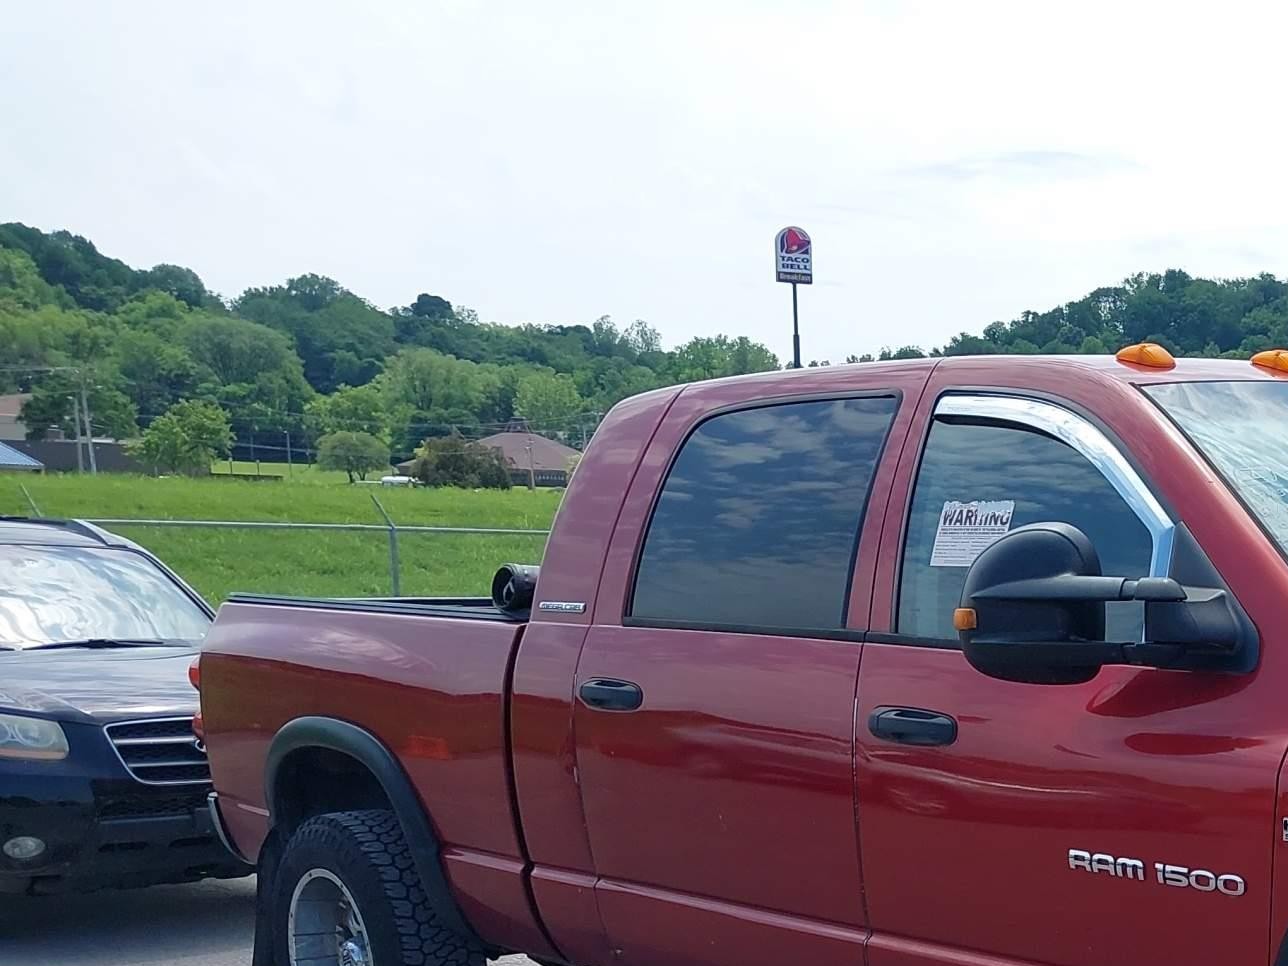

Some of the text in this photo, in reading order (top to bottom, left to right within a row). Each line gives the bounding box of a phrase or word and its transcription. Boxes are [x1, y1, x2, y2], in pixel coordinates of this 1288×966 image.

[780, 255, 809, 263] TACO
[943, 508, 1011, 526] WARNING
[1068, 849, 1245, 896] RAM 1500
